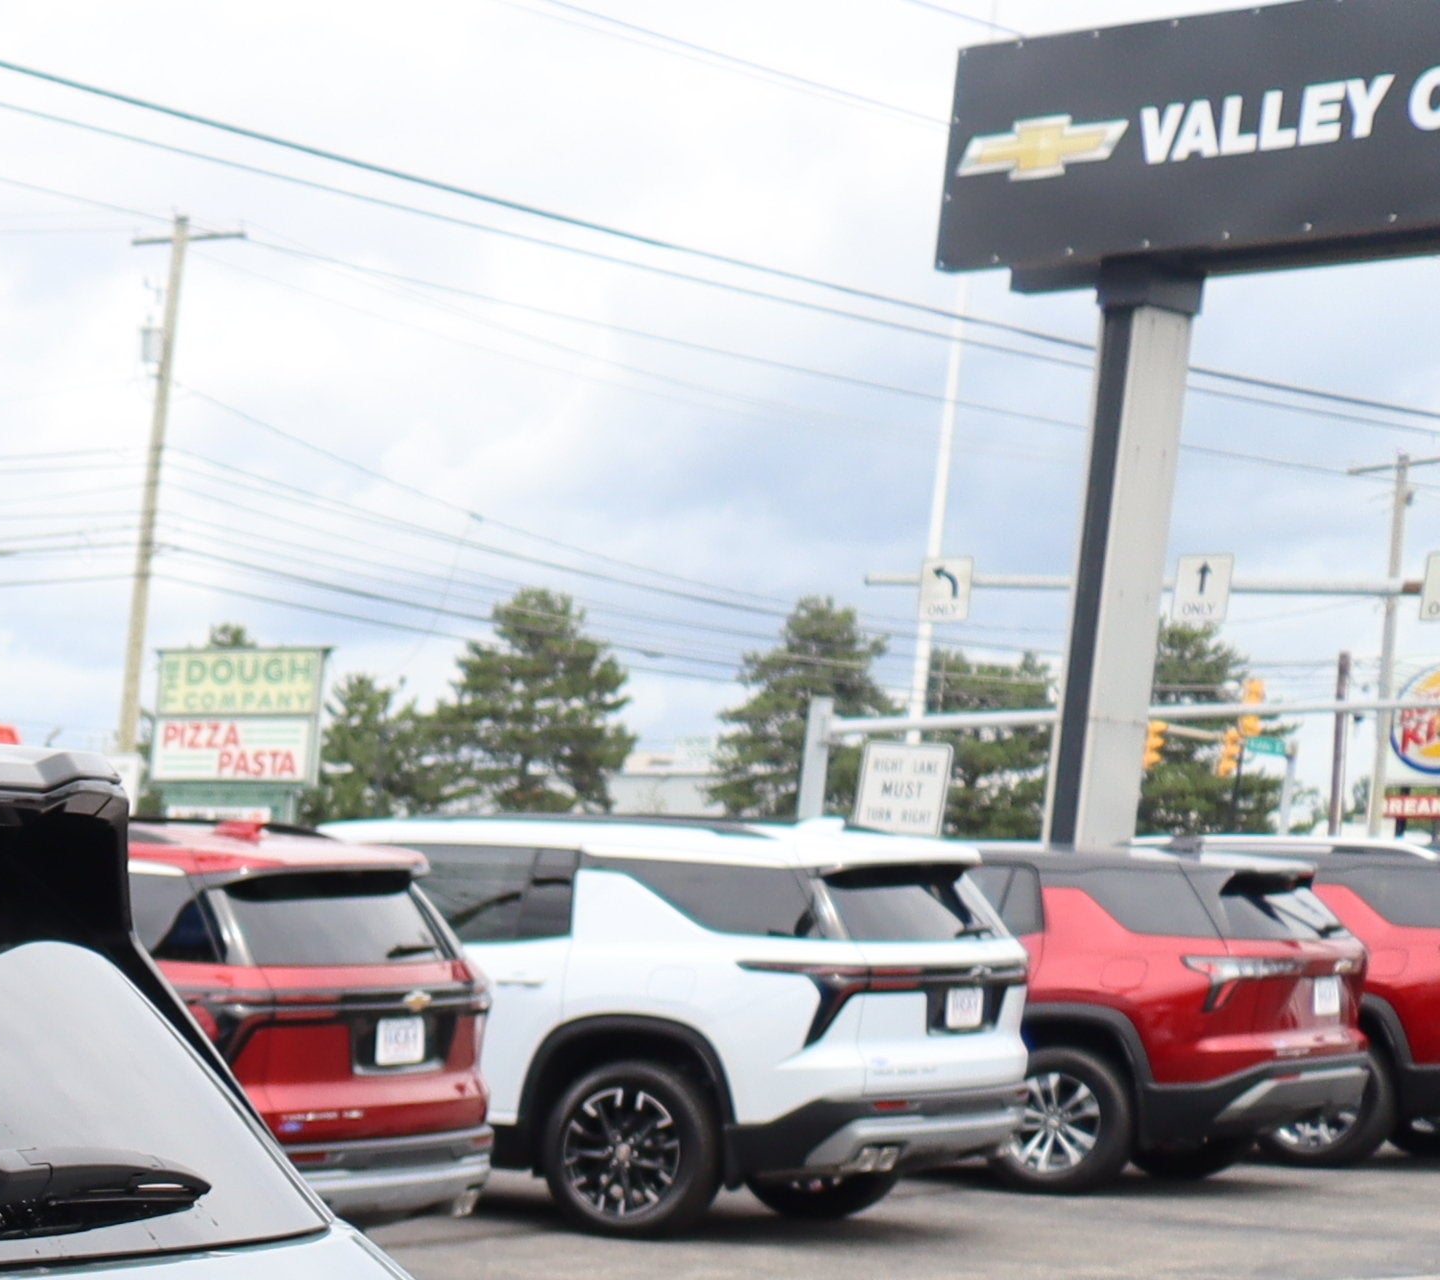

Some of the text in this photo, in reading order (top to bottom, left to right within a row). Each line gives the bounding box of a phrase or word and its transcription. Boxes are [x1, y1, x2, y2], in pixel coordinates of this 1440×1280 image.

[1140, 73, 1395, 165] VALLEY
[928, 603, 959, 616] ONLY
[1182, 602, 1215, 616] ONLY
[186, 658, 311, 685] DOUGH
[184, 692, 310, 708] COMPANY
[163, 722, 241, 749] PIZZA
[217, 750, 297, 777] PASTA
[873, 757, 939, 775] RIGHT LANE
[881, 781, 924, 798] MUST
[867, 806, 932, 824] TURN RIGHT
